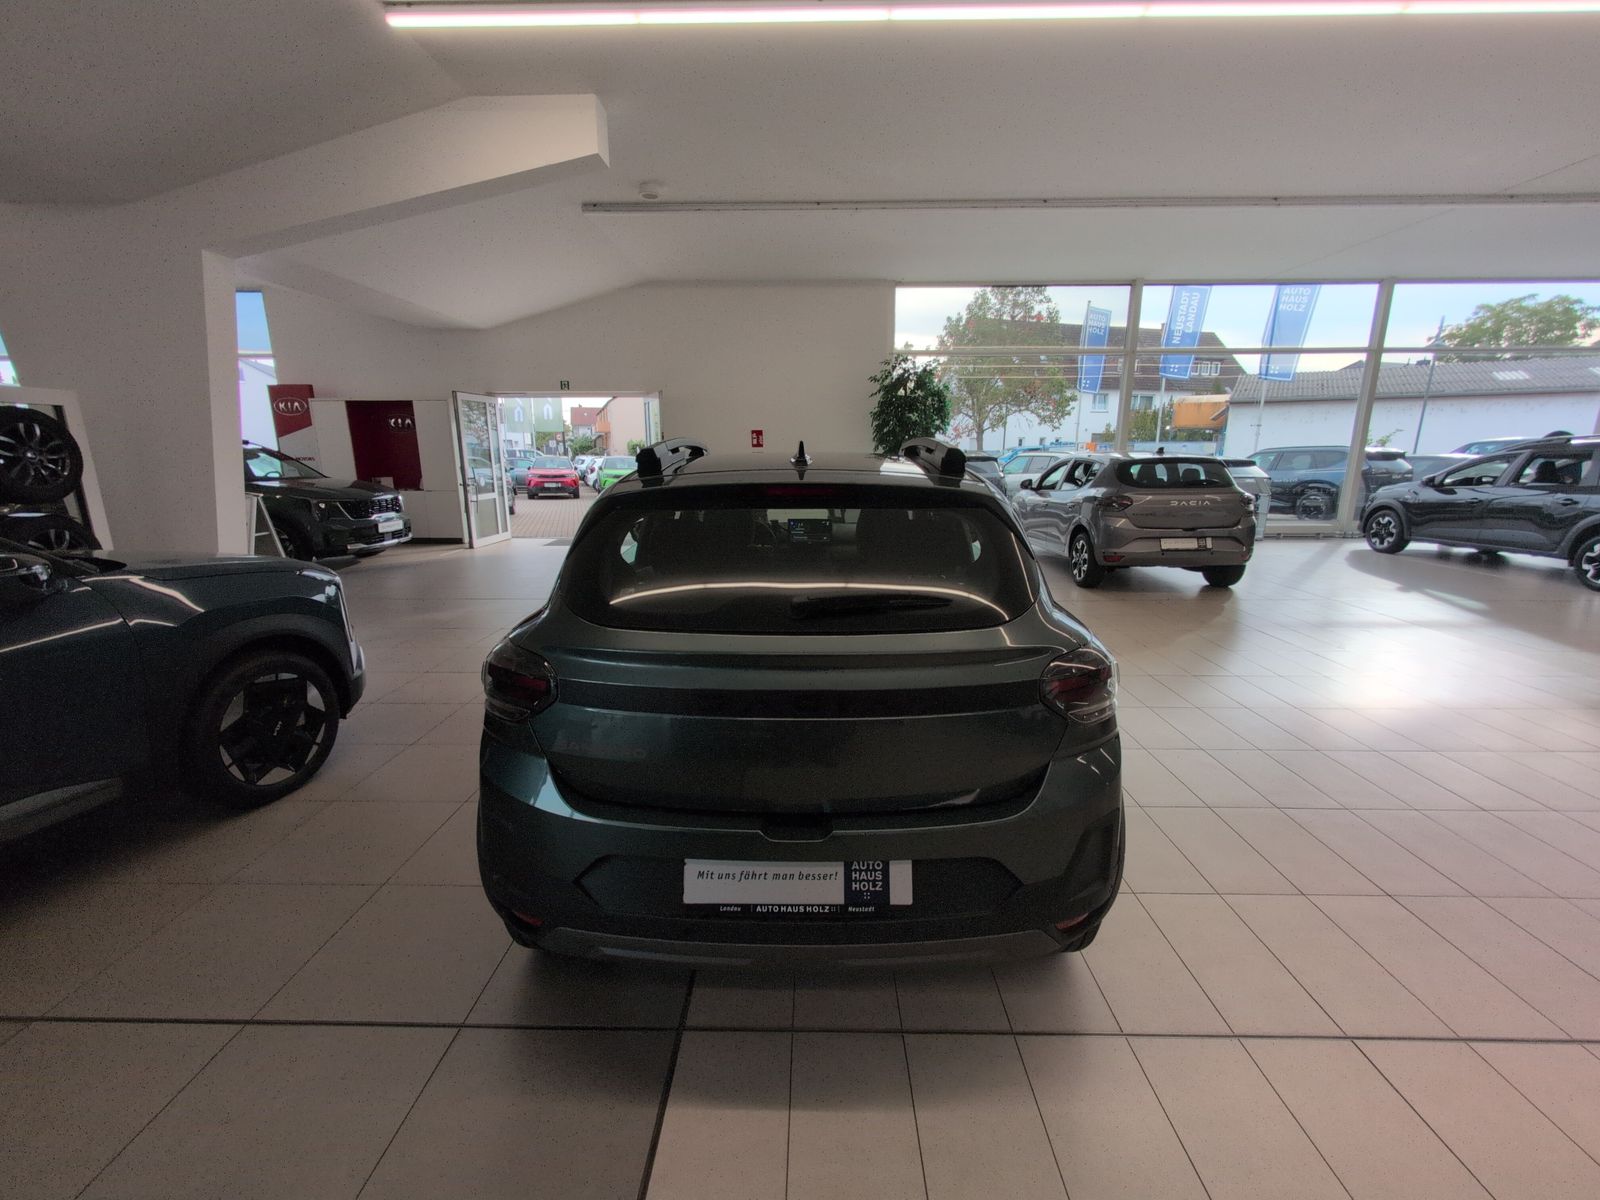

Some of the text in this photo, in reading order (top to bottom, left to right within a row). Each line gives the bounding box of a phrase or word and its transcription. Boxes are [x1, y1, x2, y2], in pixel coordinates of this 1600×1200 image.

[1282, 295, 1309, 303] HAUS
[1280, 303, 1305, 312] HOLZ
[1089, 313, 1106, 321] AUTO
[1185, 292, 1200, 333] LANDAU
[1172, 291, 1190, 344] NEUSTADT
[1088, 320, 1105, 329] HAUS
[1088, 328, 1105, 336] HOLZ
[278, 402, 301, 412] KIA
[851, 861, 883, 870] AUTO
[697, 871, 839, 883] Mit uns fährt man besser!
[851, 871, 883, 881] HAUS
[851, 882, 883, 891] HOLZ
[805, 905, 830, 913] HOLZ
